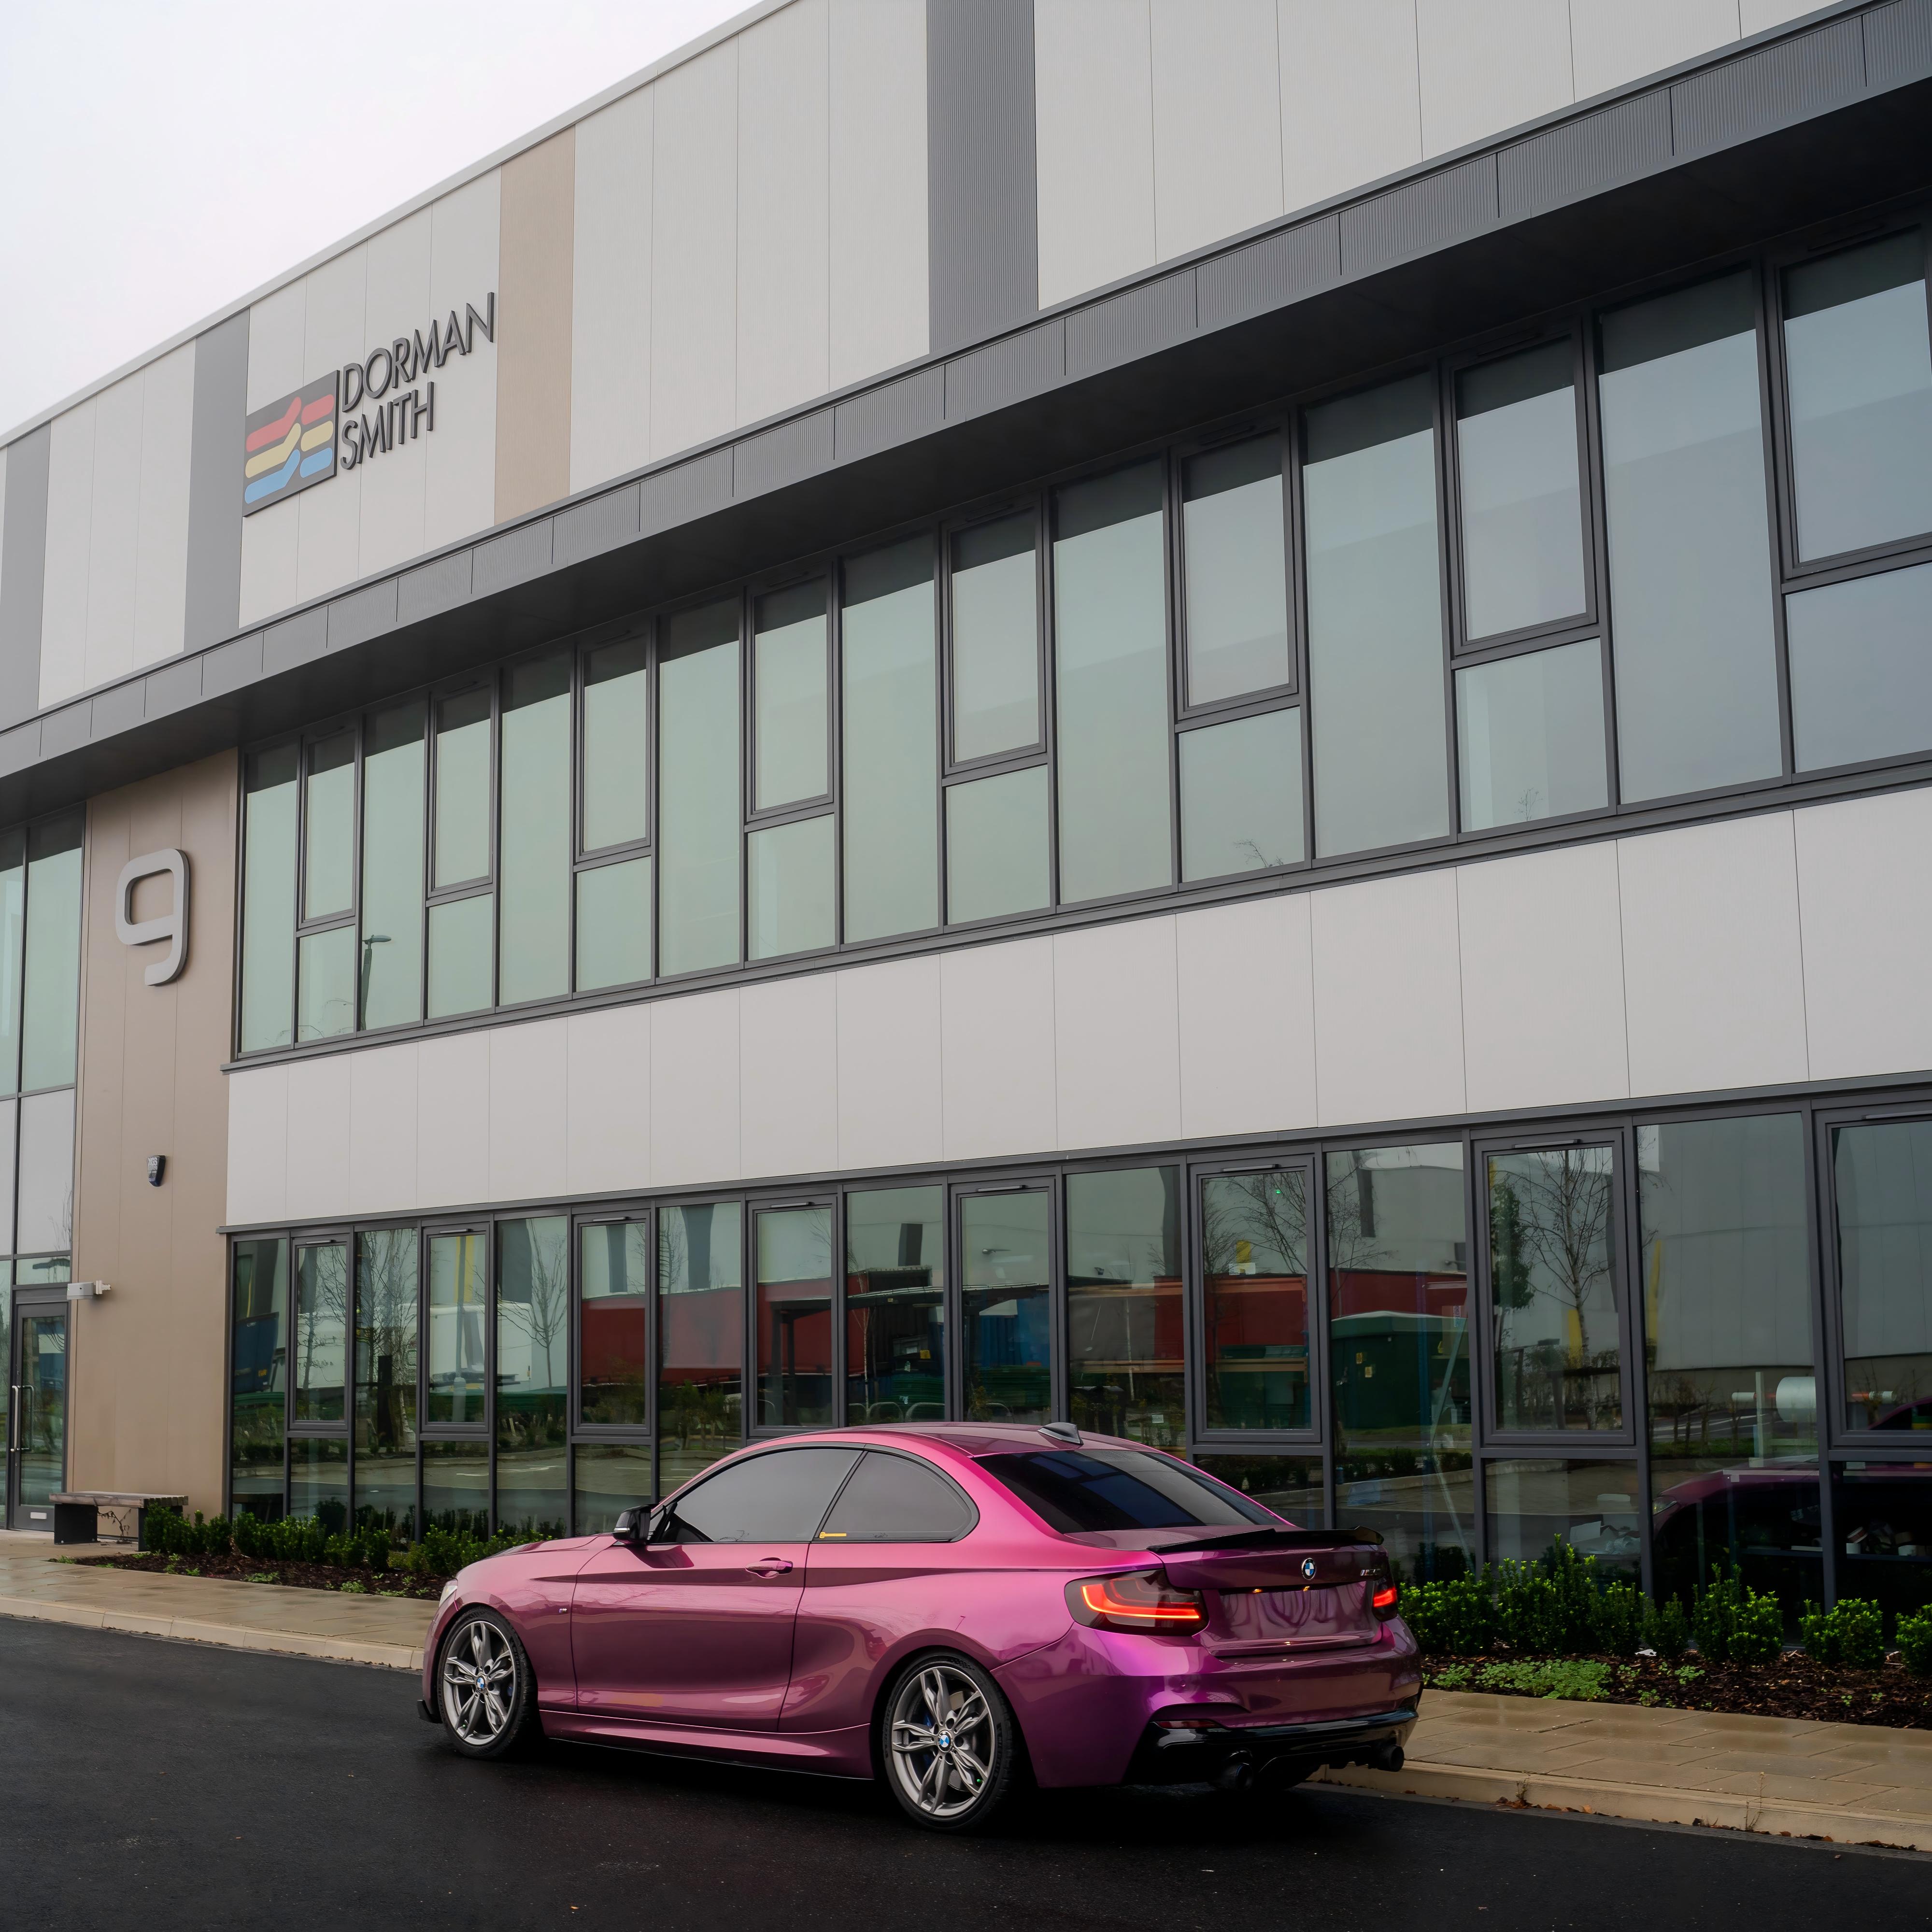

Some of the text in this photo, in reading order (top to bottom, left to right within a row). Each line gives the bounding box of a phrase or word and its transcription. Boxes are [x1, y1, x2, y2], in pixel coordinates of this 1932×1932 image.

[341, 292, 495, 413] DORMAN
[340, 381, 435, 470] SMITH
[115, 848, 189, 986] 9
